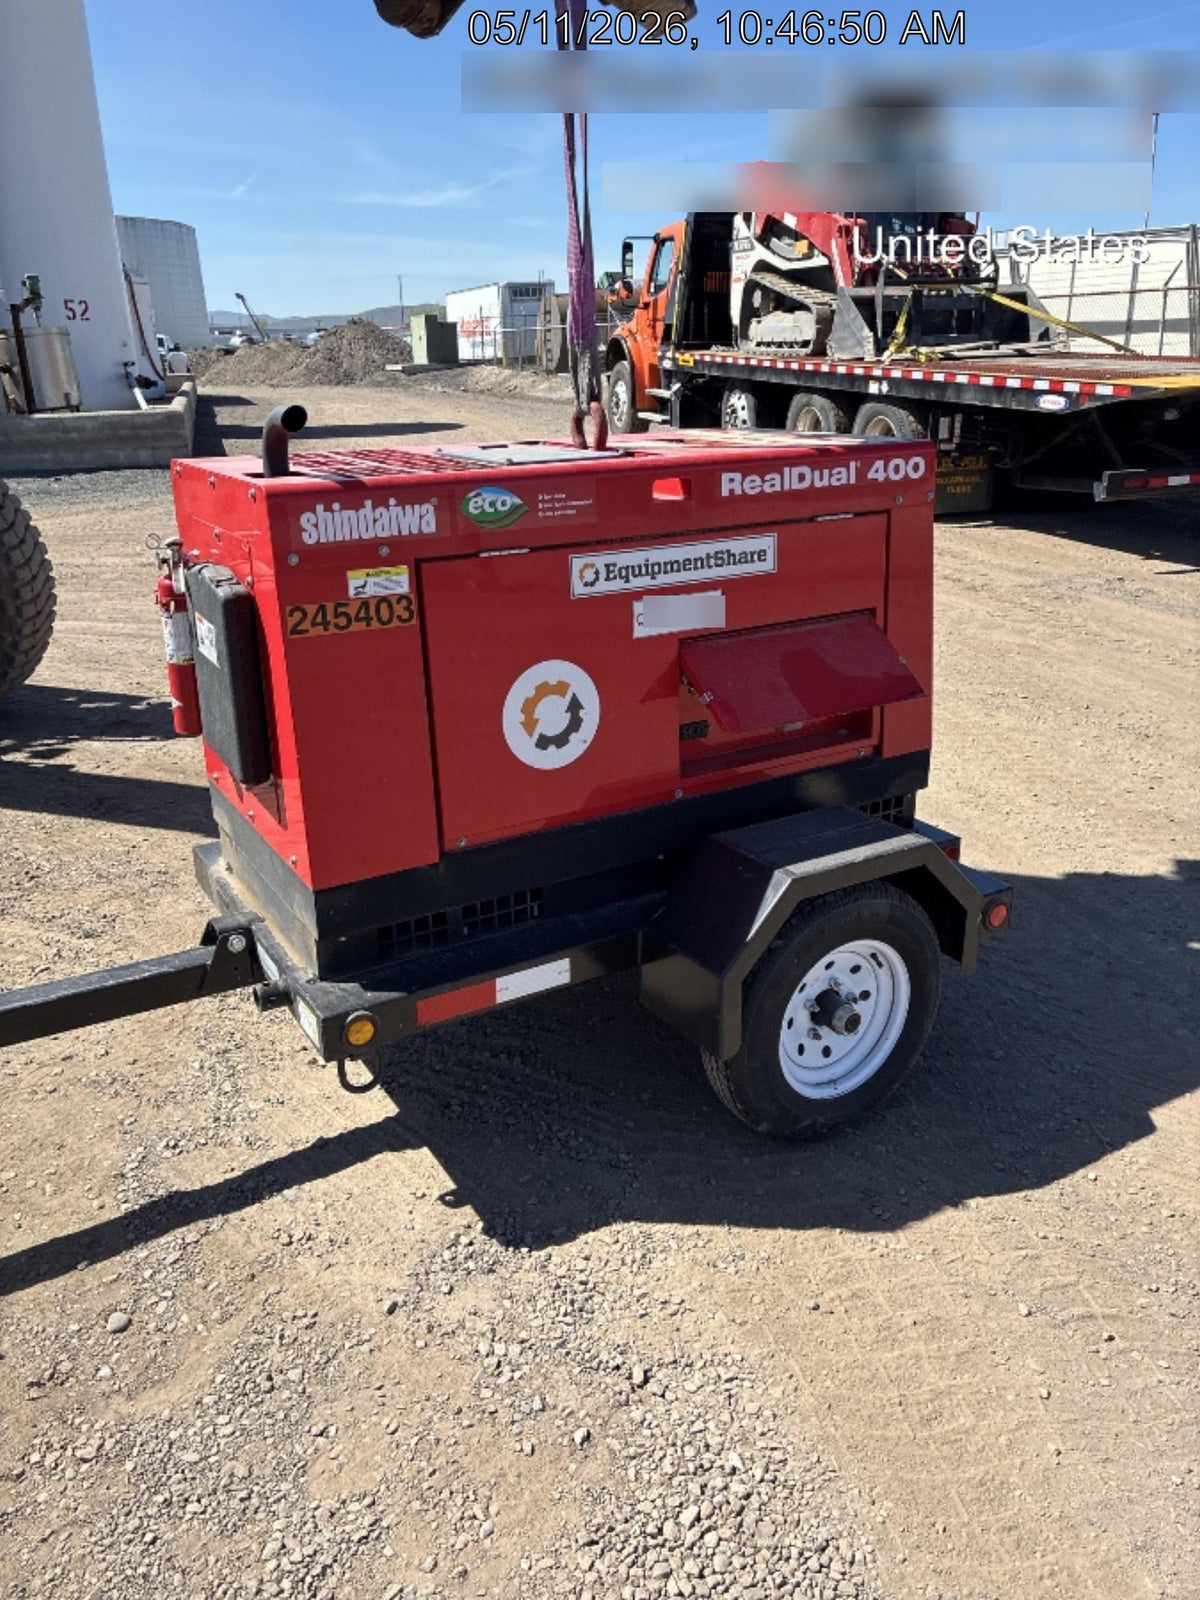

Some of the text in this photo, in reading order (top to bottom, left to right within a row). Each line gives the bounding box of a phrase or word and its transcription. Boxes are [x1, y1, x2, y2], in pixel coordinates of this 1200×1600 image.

[64, 299, 91, 321] 52
[721, 461, 858, 497] RealDual
[867, 456, 926, 483] 400
[300, 497, 437, 545] shindaiwa
[604, 548, 768, 584] EquipmentShare
[288, 595, 416, 637] 245403
